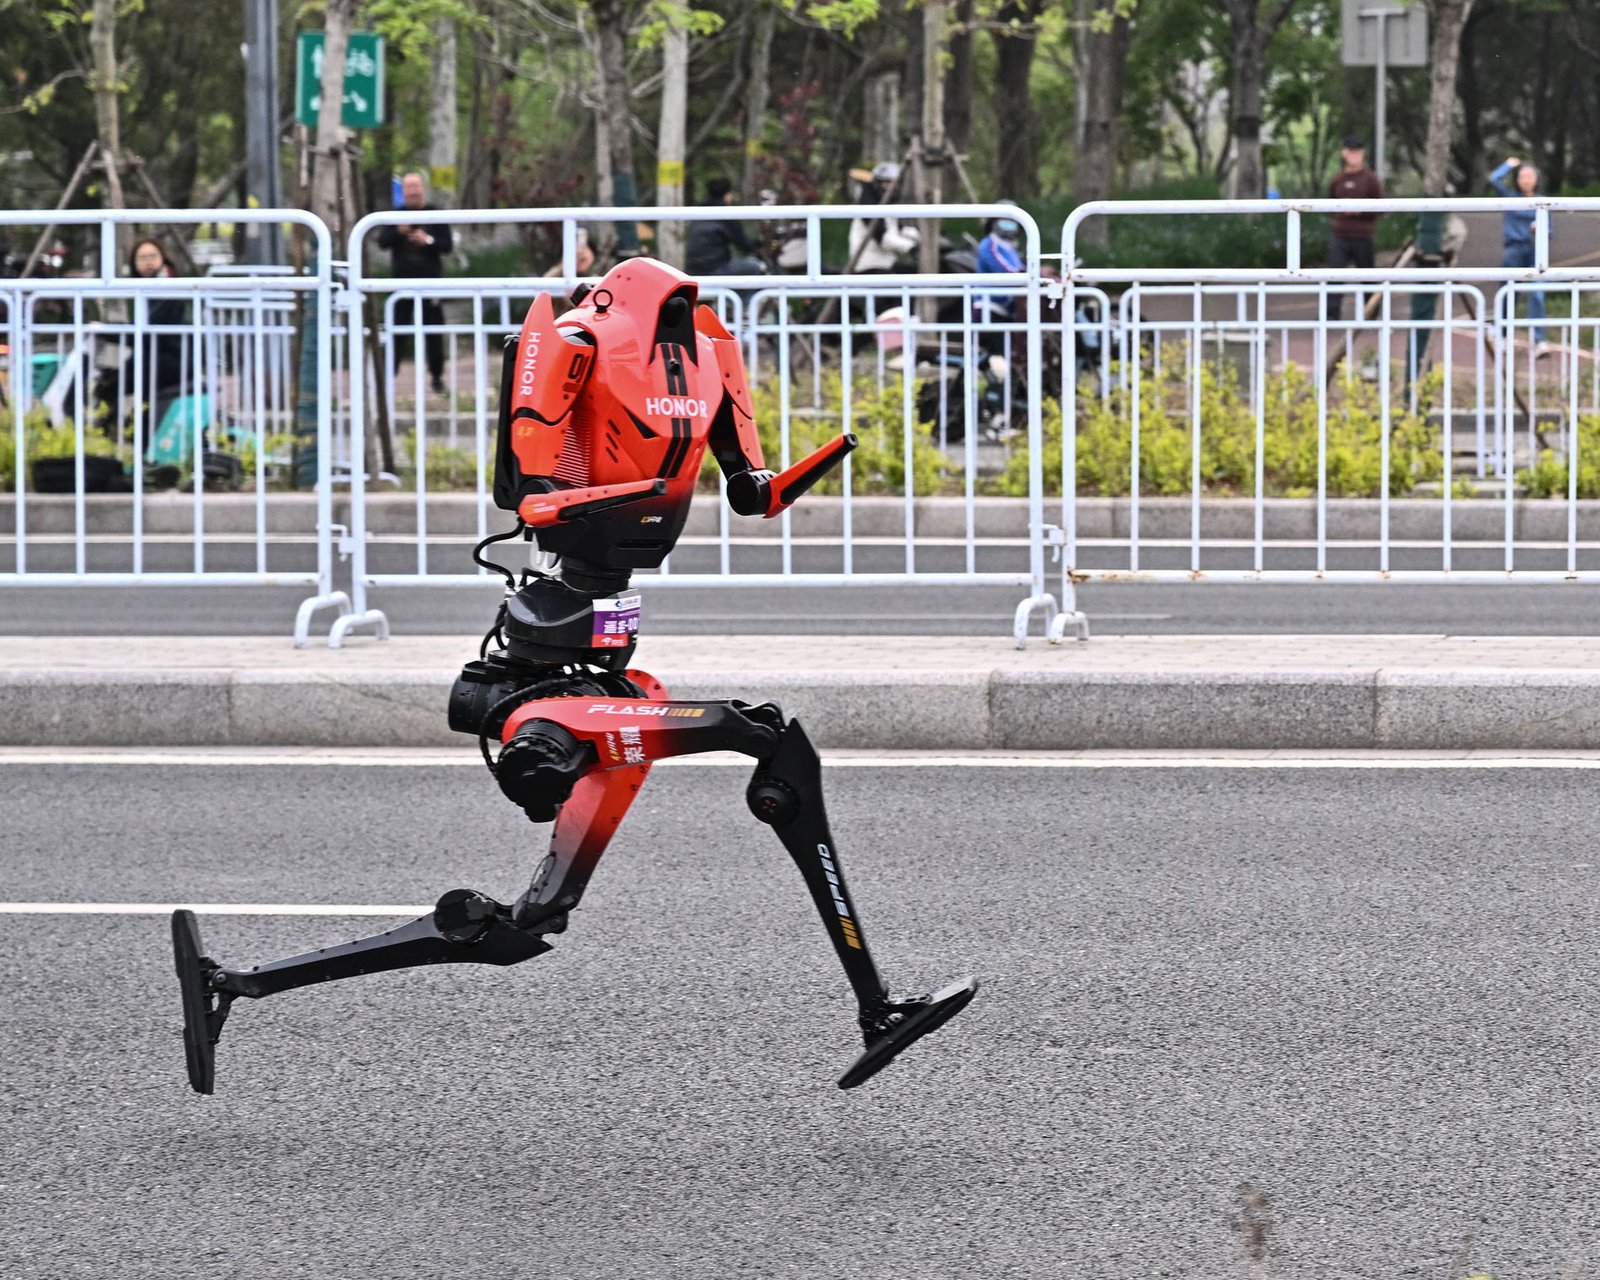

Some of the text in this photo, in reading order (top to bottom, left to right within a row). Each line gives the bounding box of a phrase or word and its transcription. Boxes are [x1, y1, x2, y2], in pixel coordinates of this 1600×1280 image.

[520, 332, 542, 396] HONOR
[645, 397, 708, 418] HONOR
[587, 704, 669, 716] FLASH
[817, 843, 850, 917] SPEED
